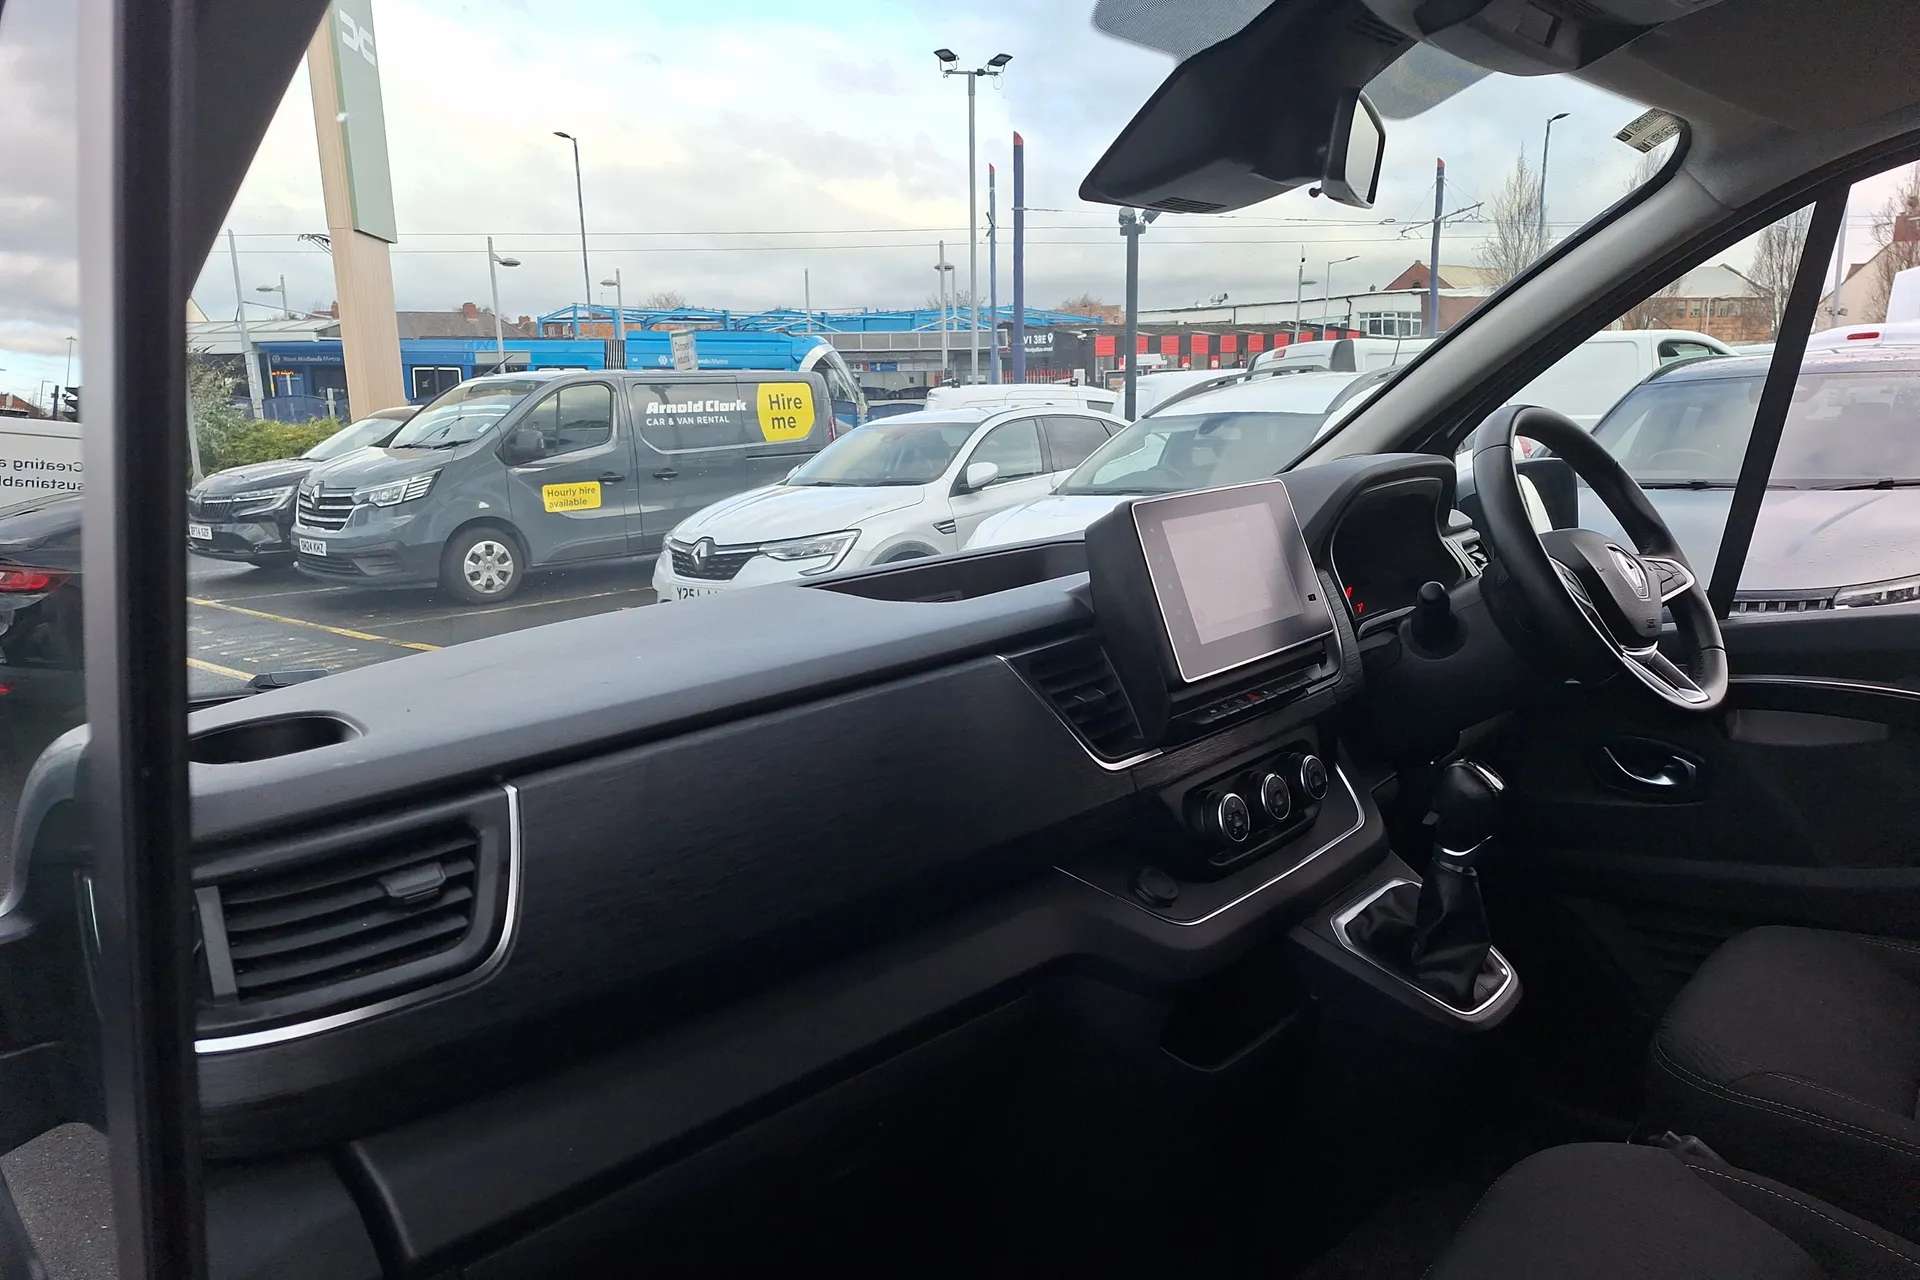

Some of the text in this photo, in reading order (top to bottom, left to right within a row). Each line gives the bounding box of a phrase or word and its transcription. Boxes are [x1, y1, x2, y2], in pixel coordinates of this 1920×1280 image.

[645, 399, 747, 415] Arnold Clark
[768, 393, 802, 410] Hire
[646, 415, 730, 426] CAR & VAN RENTAL
[771, 416, 797, 430] me
[547, 485, 596, 498] Hourly hire
[549, 497, 588, 509] available
